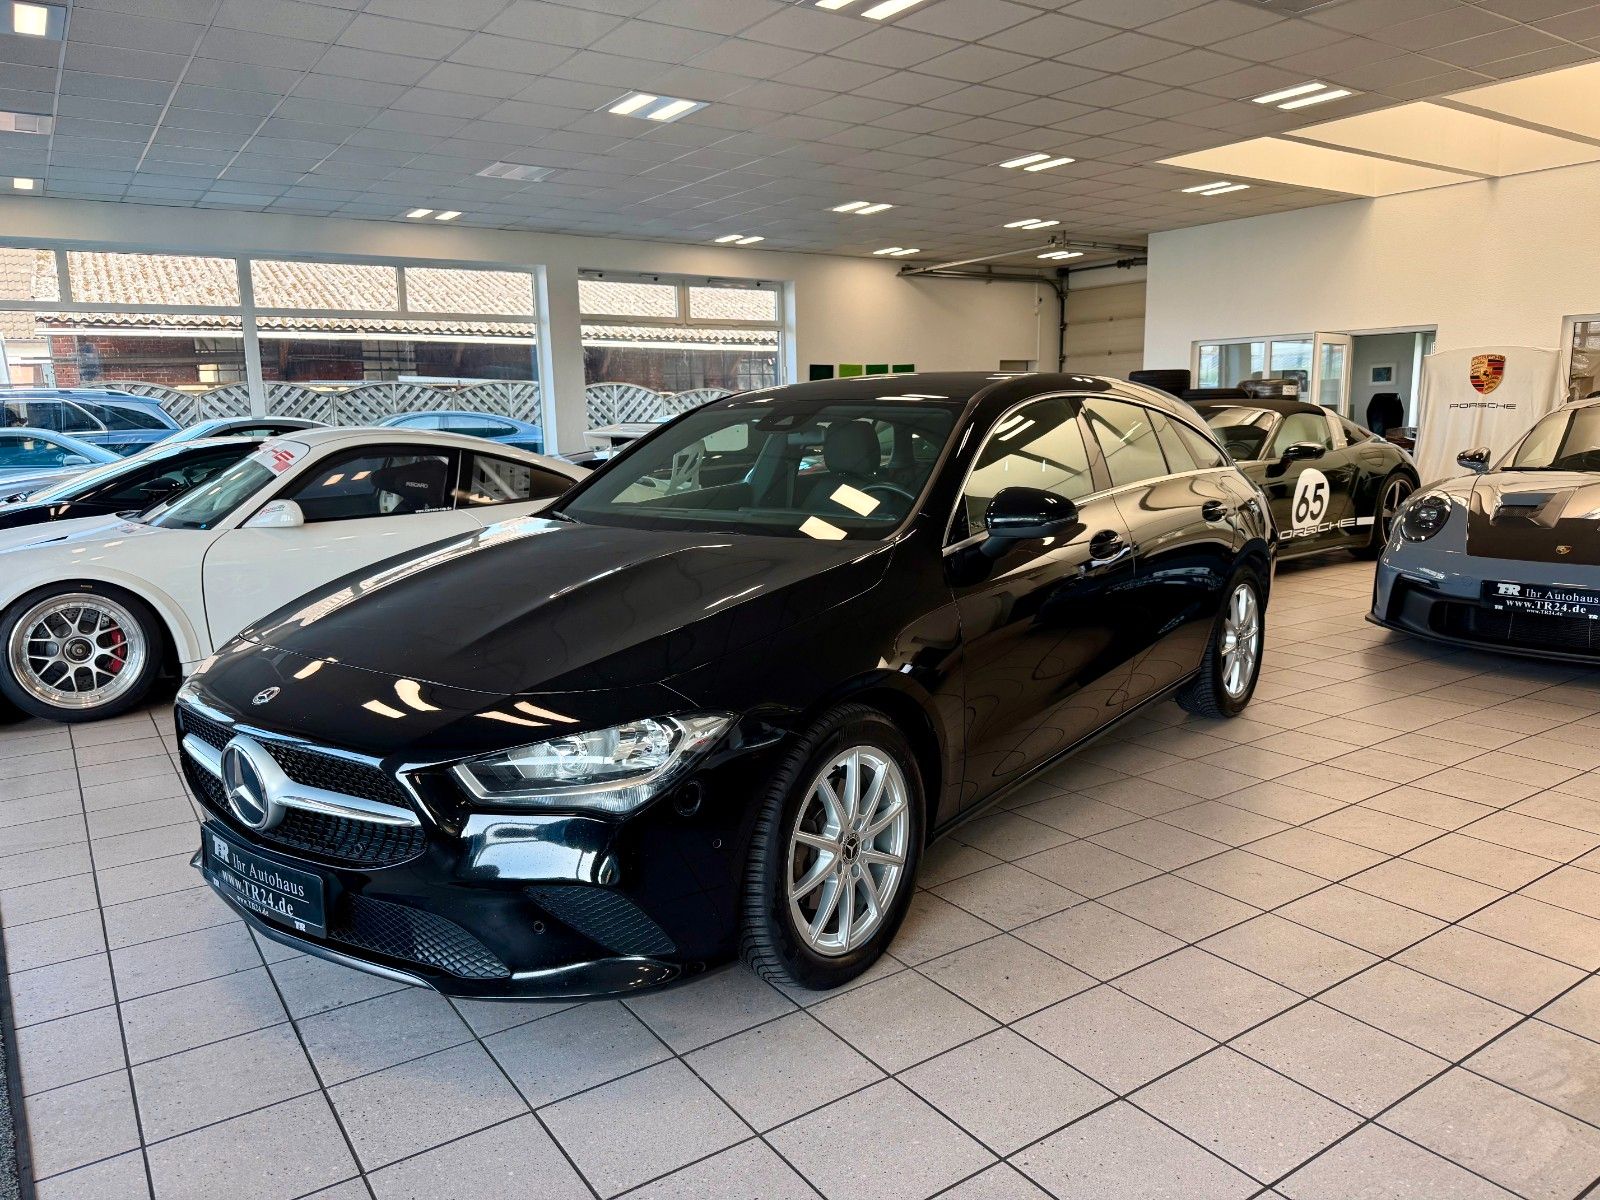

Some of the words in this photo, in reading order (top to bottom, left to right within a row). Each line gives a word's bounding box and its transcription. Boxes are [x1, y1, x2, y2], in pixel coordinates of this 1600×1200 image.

[1449, 402, 1516, 410] PORSCHE
[1295, 482, 1325, 523] 65
[1277, 517, 1356, 540] ORSCHE
[1505, 599, 1587, 614] www.TR24.de
[1526, 588, 1542, 598] Ihr
[1545, 591, 1599, 604] Autohaus
[232, 852, 247, 874] Ihr
[249, 862, 305, 898] Autohaus
[221, 869, 294, 917] www.TR24.de
